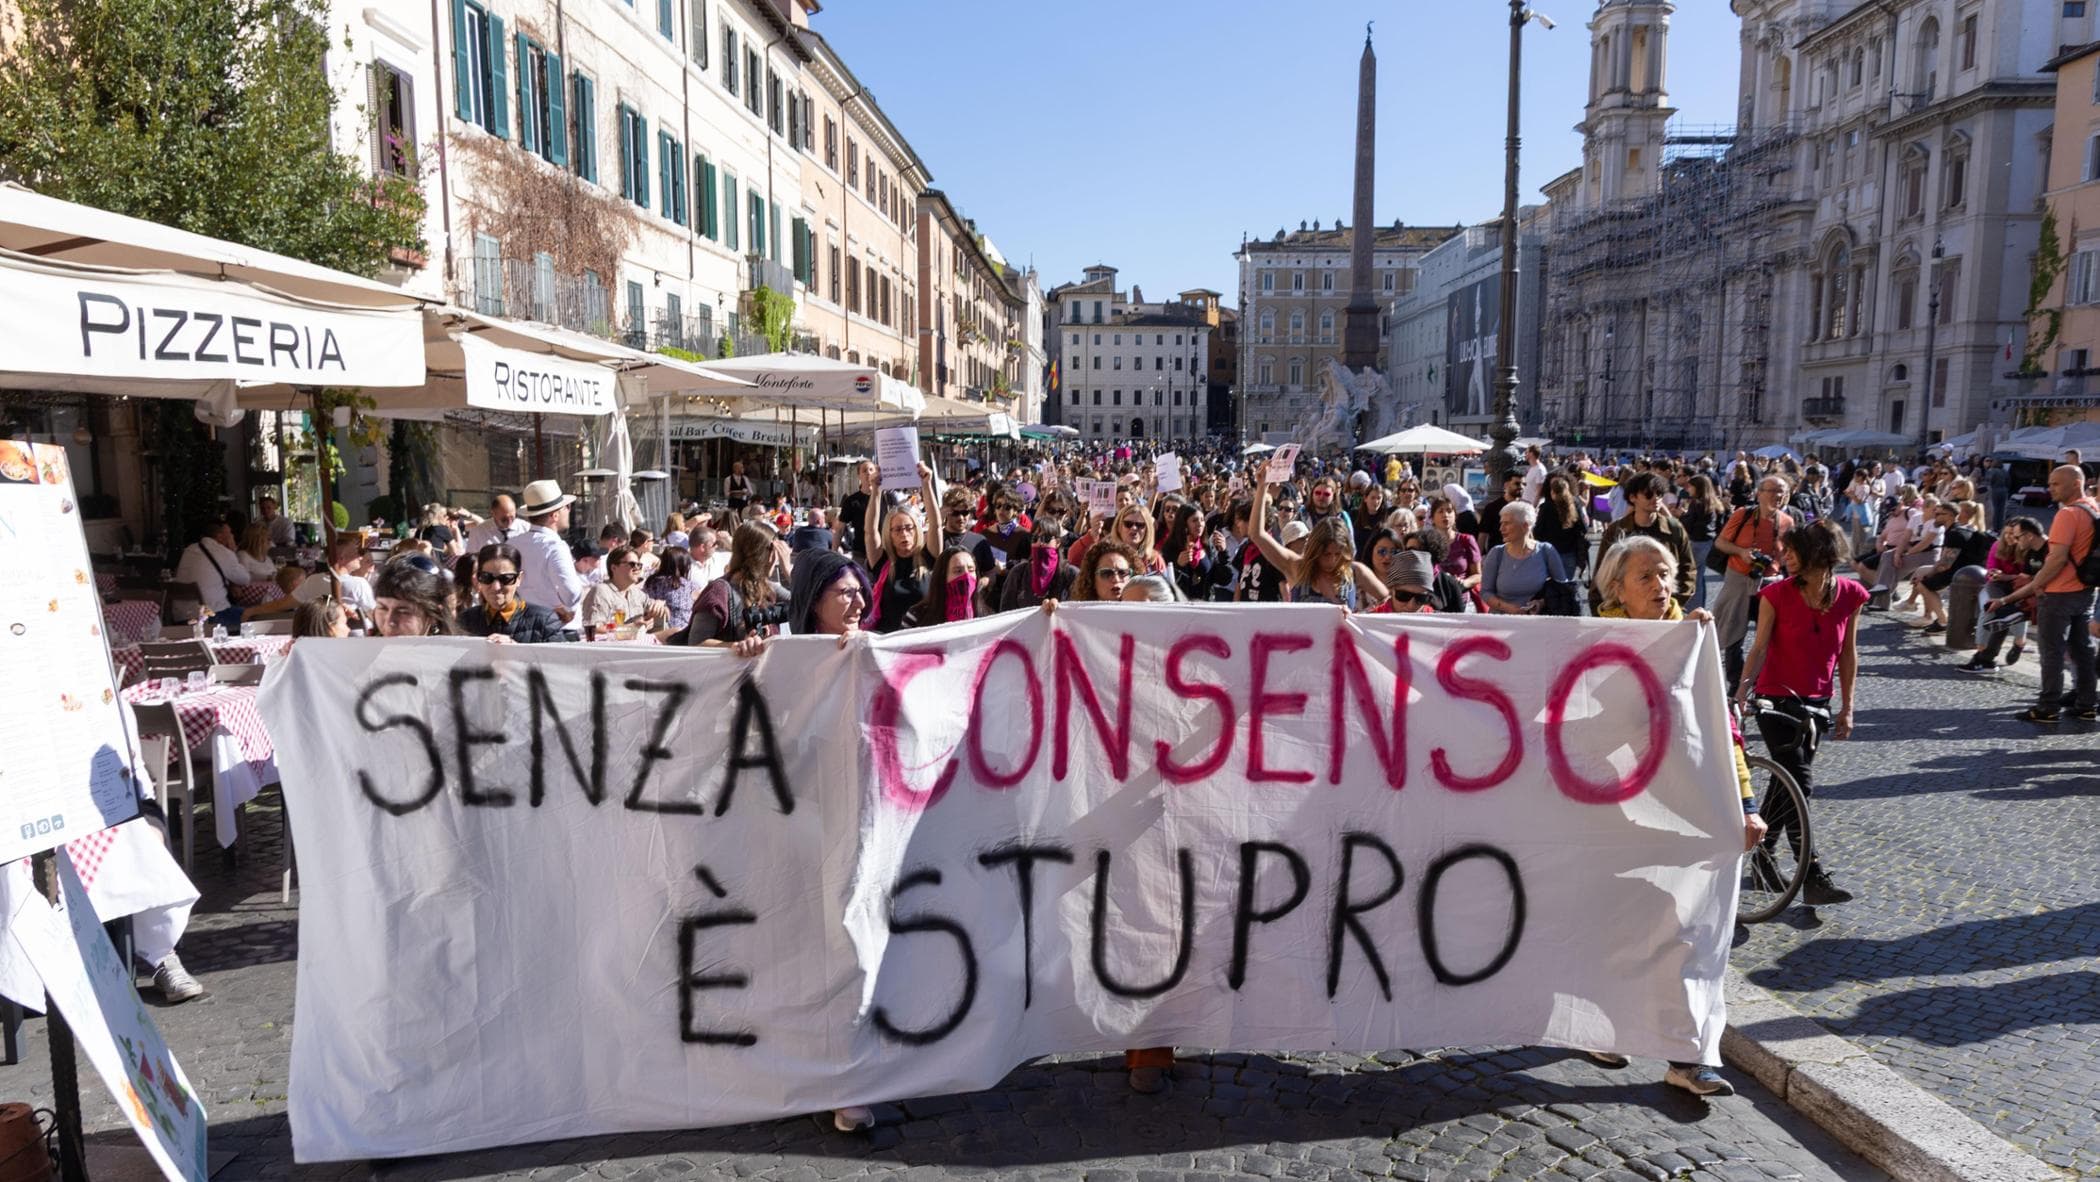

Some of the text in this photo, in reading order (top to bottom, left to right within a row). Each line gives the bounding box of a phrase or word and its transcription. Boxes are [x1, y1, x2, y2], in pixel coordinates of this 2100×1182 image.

[78, 291, 346, 371] PIZZERIA
[494, 361, 602, 406] RISTORANTE
[685, 426, 707, 437] Bar
[355, 627, 1673, 816] SENZA CONSENSO
[678, 831, 1528, 1046] È STUPRO
